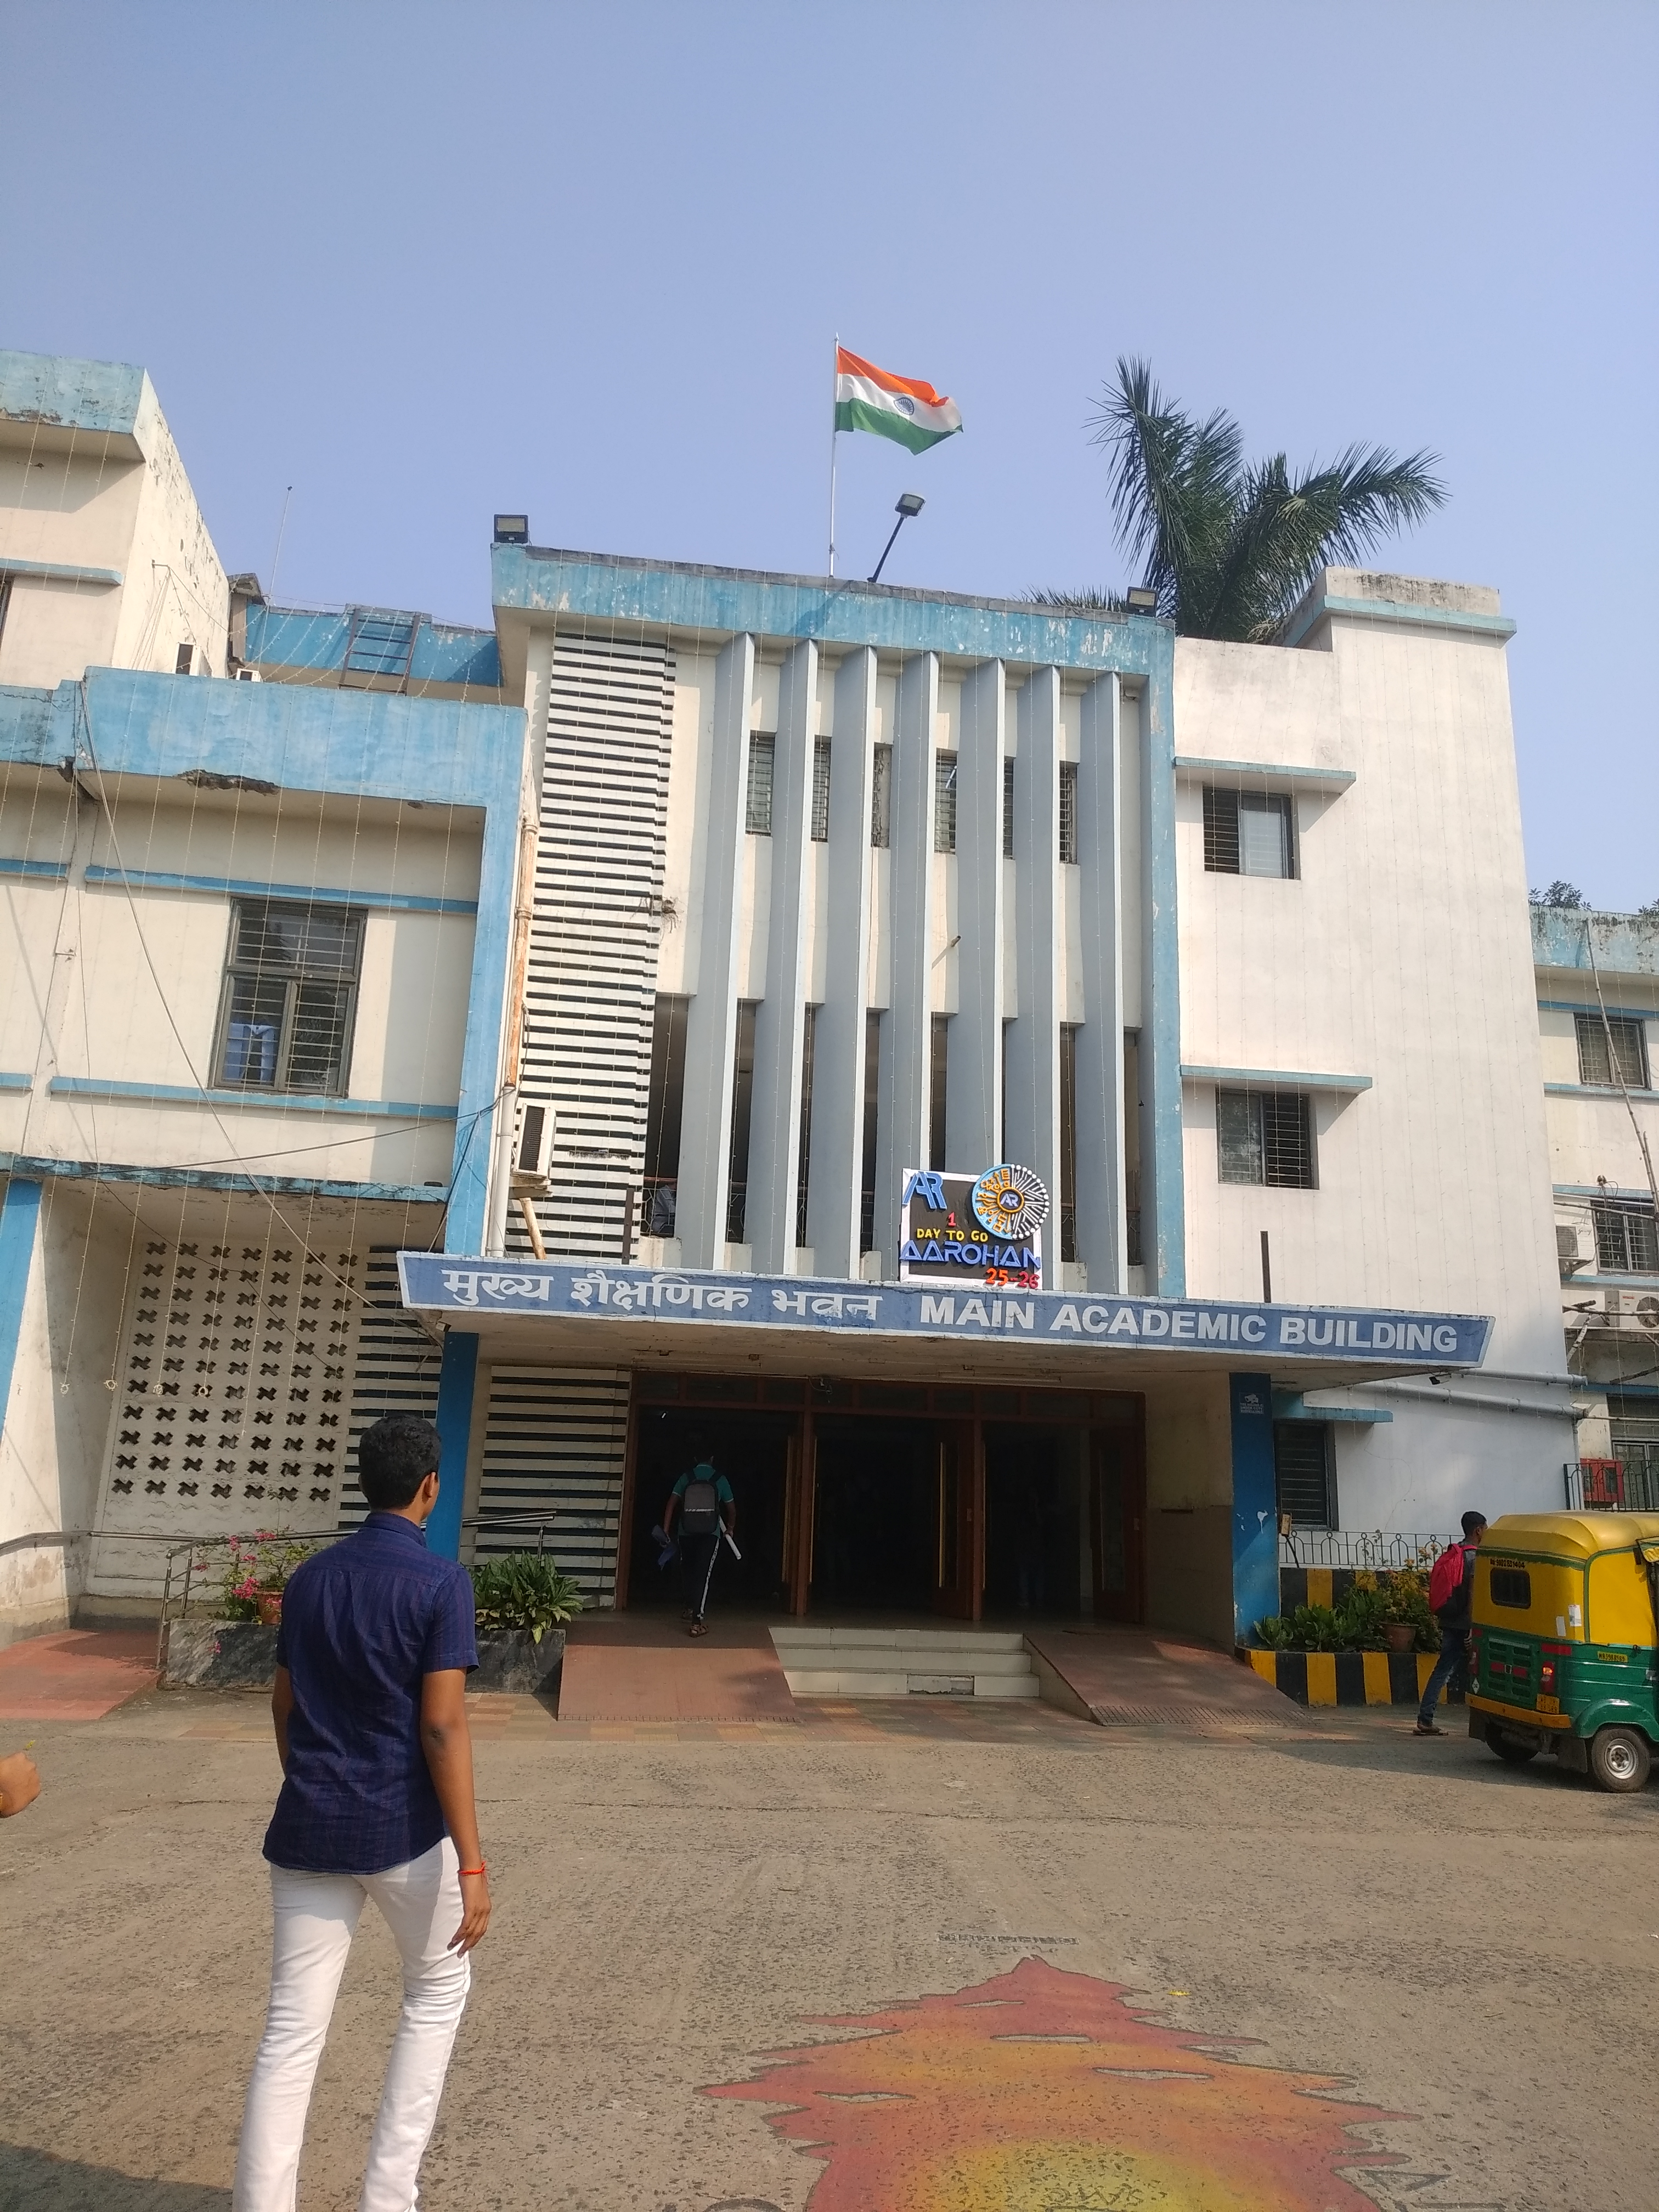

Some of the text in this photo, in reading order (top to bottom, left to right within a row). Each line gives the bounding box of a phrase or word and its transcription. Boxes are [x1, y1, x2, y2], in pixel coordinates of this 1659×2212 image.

[902, 1171, 947, 1210] AR
[1000, 1193, 1020, 1207] AR
[947, 1211, 956, 1227] 1
[917, 1228, 988, 1242] DAY TO GO
[900, 1240, 1041, 1268] AAROHAN
[986, 1268, 1040, 1289] 25-26
[441, 1269, 883, 1321] मुख्य शैक्षणिक भवन
[921, 1295, 1457, 1352] MAIN ACADEMIC BUILDING
